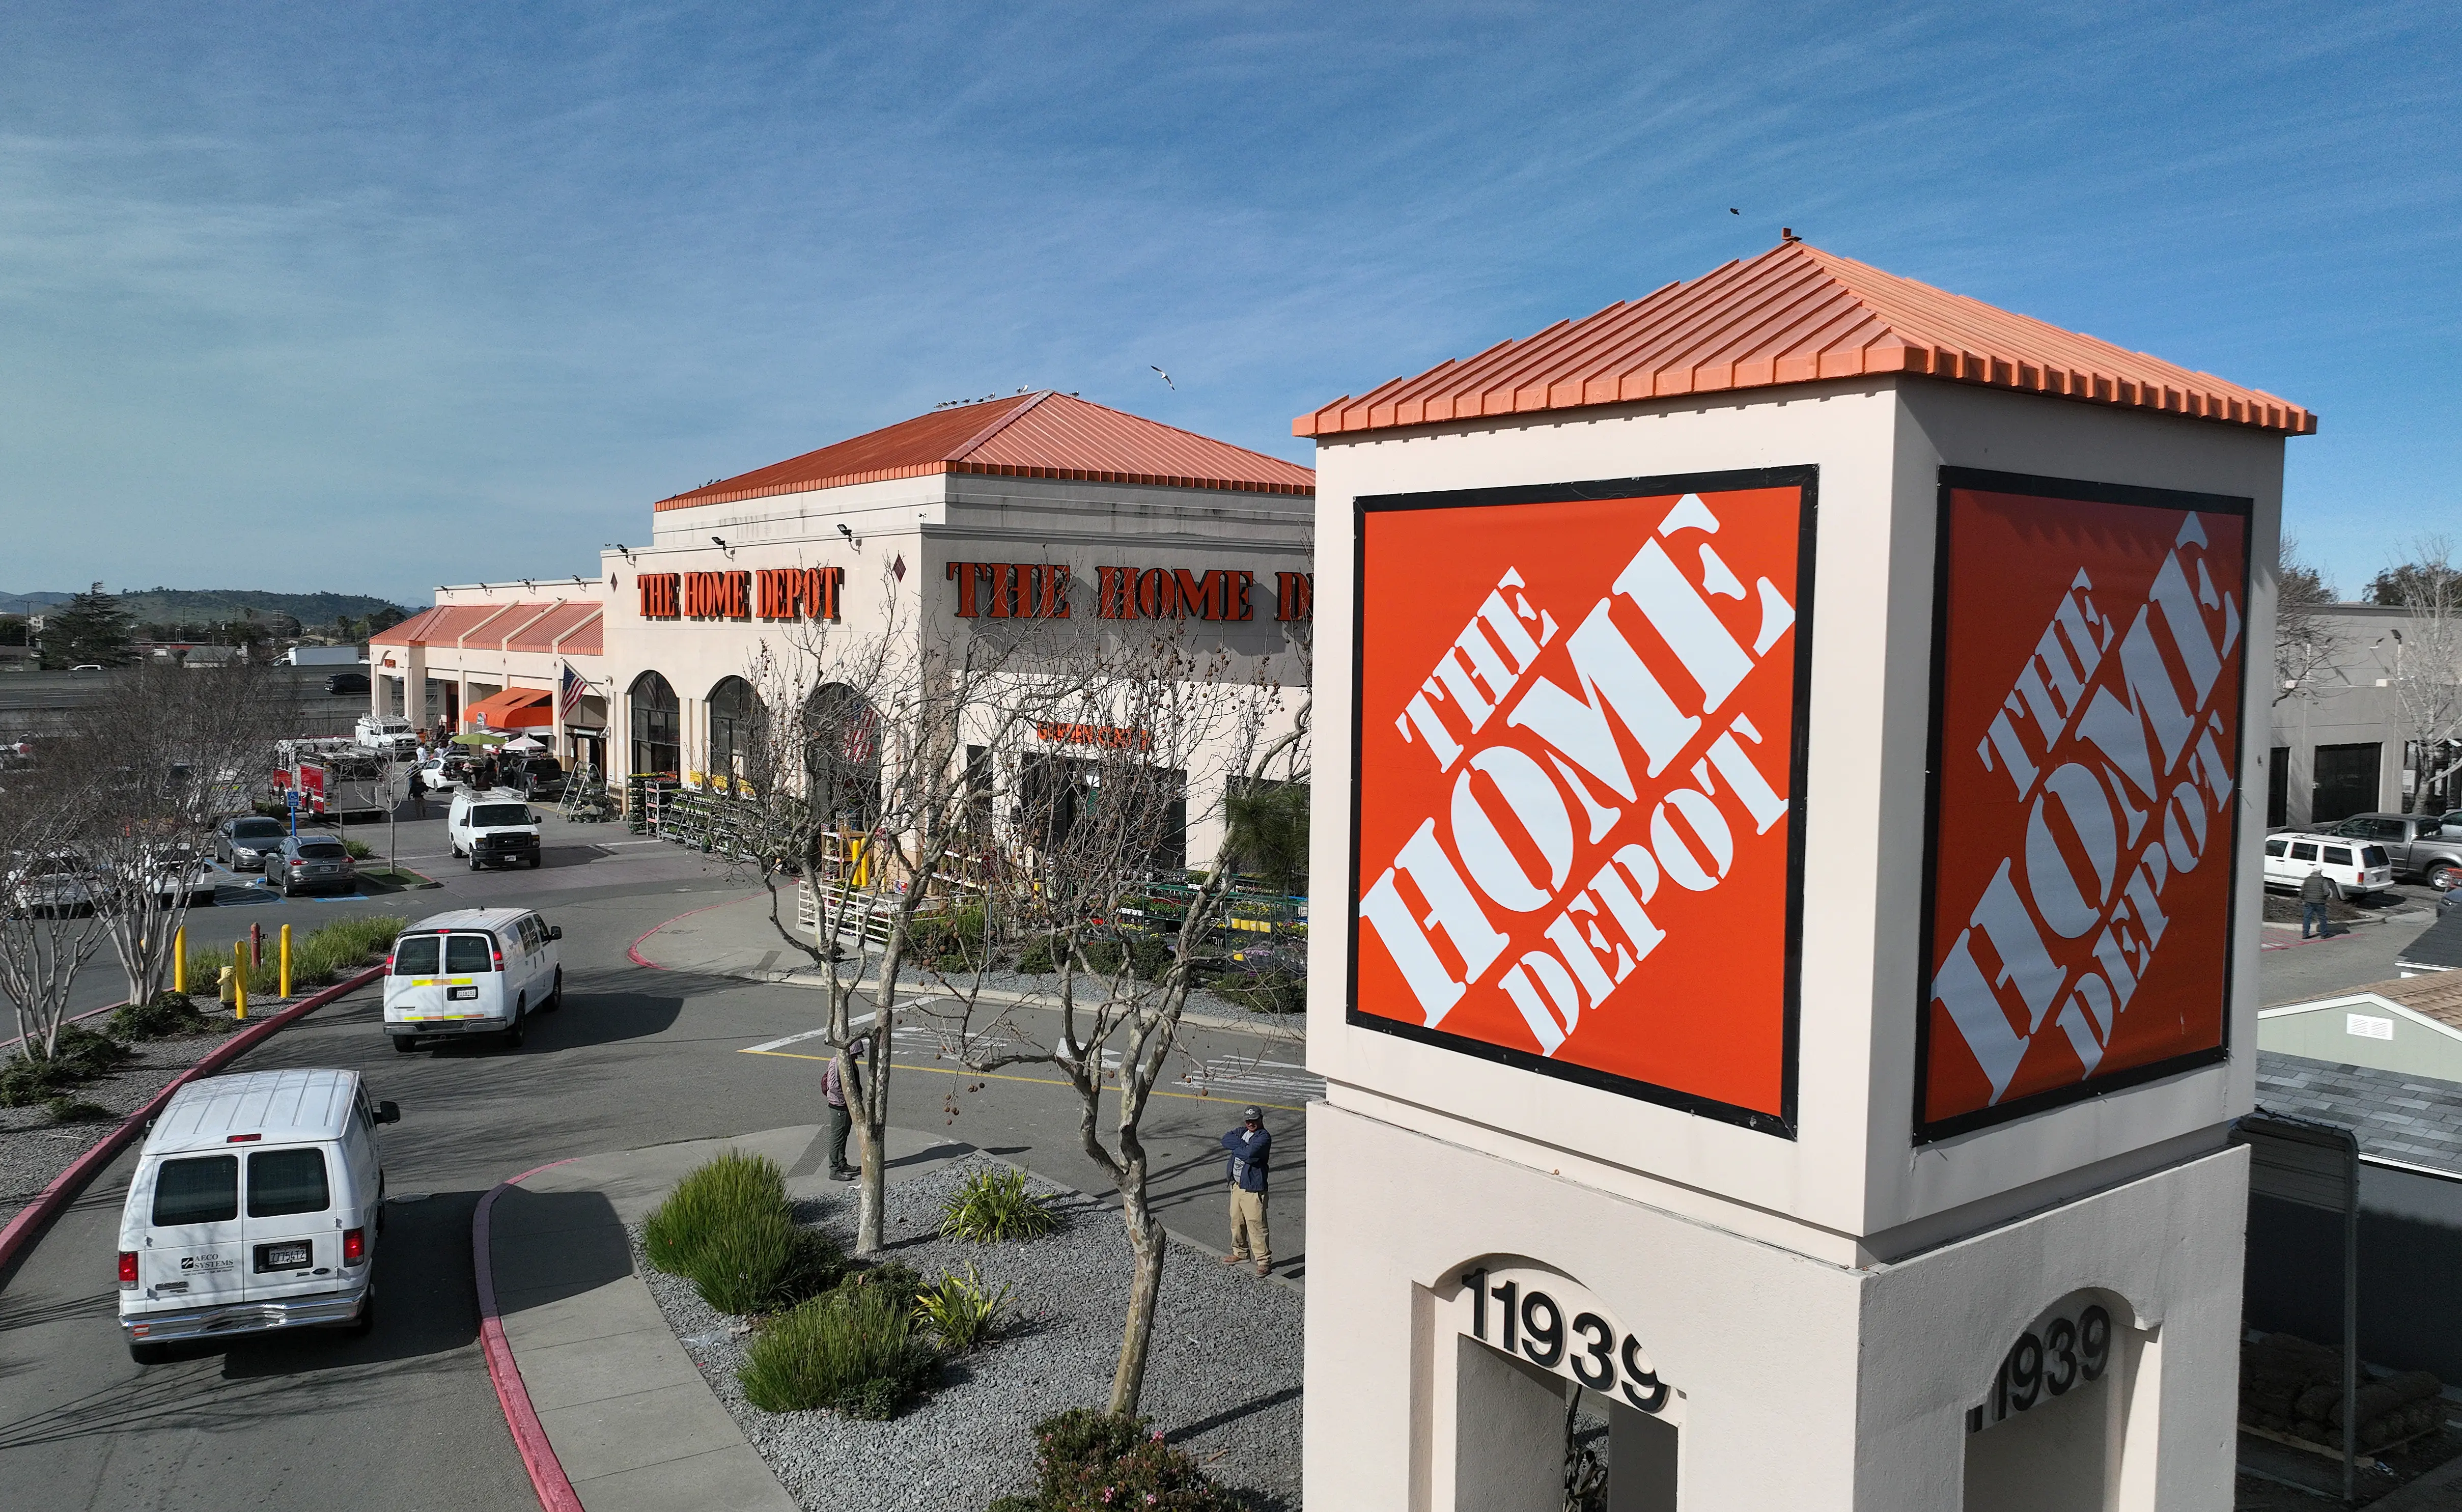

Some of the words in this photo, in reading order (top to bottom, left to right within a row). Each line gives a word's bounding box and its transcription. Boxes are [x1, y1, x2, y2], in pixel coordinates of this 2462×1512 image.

[637, 573, 676, 617] THE
[684, 571, 746, 617] HOME
[756, 567, 839, 619] DEPOT
[946, 562, 1070, 618] THE
[1095, 567, 1253, 620] HOME
[1395, 566, 1559, 773] THE
[1977, 567, 2114, 802] THE
[1359, 493, 1796, 1029] HOME
[1931, 511, 2241, 1106] HOME
[1498, 712, 1788, 1057] DEPOT
[2056, 710, 2233, 1080] DEPOT
[194, 1253, 218, 1262] AECO
[194, 1259, 234, 1269] SYSTEMS
[270, 1250, 305, 1263] 77754T2
[1462, 1268, 1670, 1413] 11939
[1966, 1305, 2111, 1432] 1939
